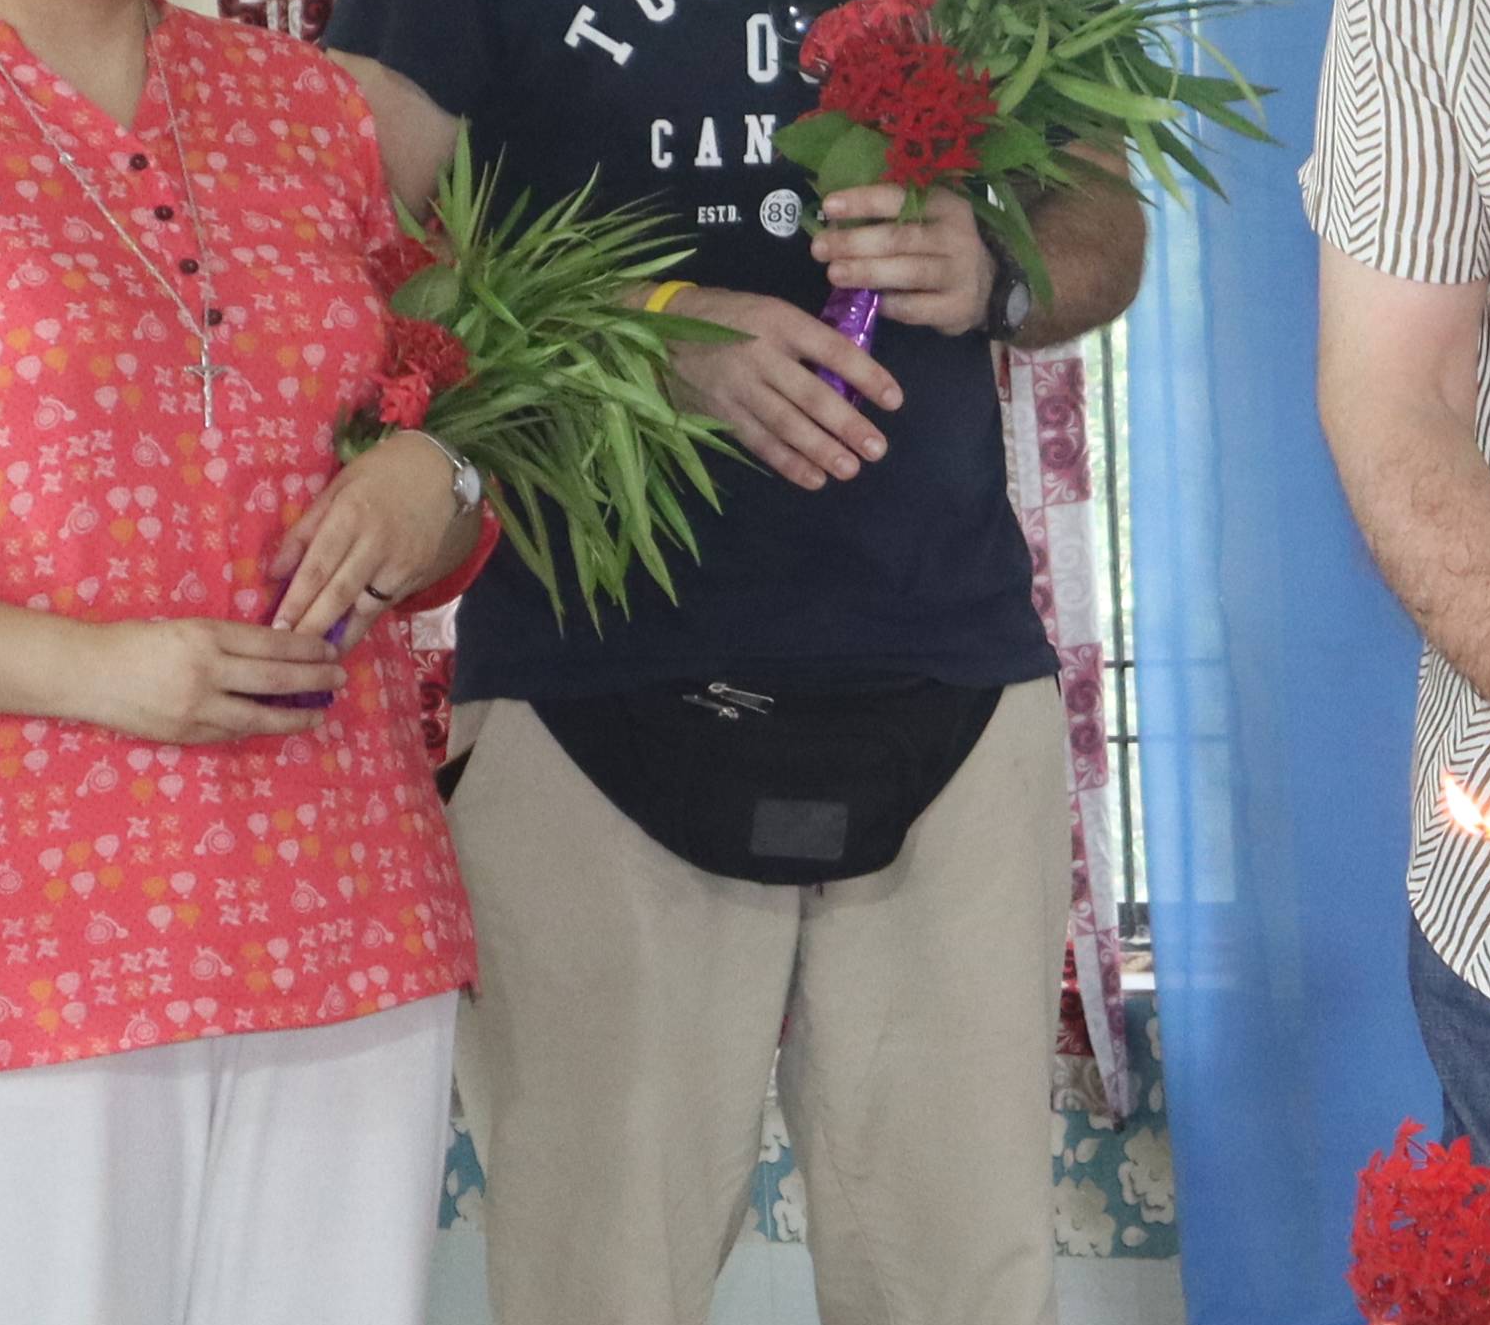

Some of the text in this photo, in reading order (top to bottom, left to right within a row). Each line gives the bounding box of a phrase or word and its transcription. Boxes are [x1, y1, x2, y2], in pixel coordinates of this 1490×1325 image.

[651, 114, 777, 169] CAN
[696, 202, 798, 224] ESTD. 89
